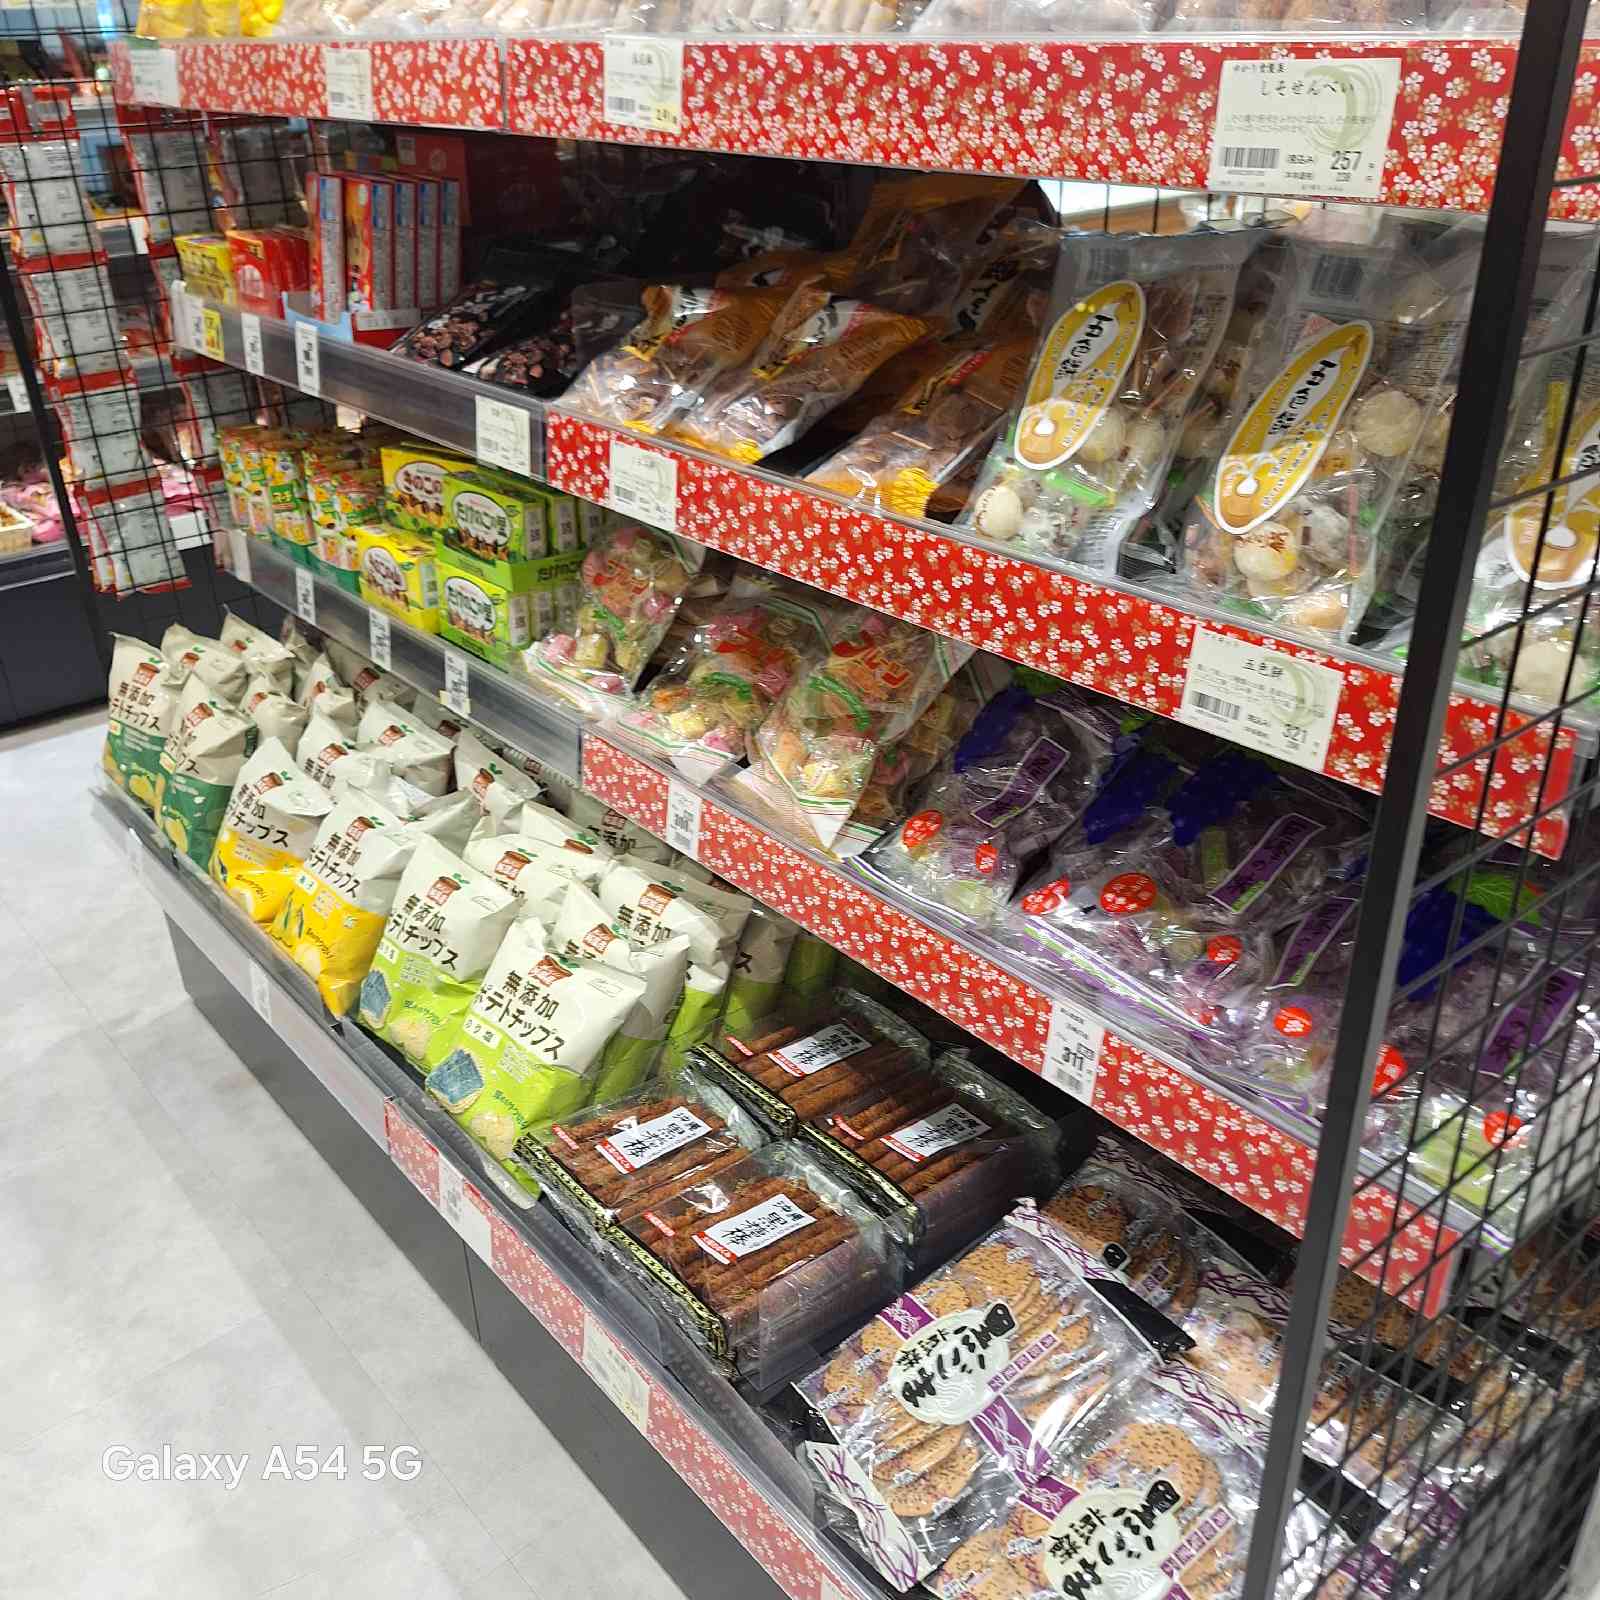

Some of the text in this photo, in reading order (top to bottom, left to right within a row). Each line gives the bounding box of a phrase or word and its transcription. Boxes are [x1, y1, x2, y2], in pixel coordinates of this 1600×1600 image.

[1261, 80, 1354, 97] しそせんべい
[1330, 150, 1362, 171] 257
[326, 831, 363, 867] 無添加
[402, 893, 446, 935] 無添加
[616, 903, 672, 945] 無添加
[502, 969, 560, 1021] 無添加
